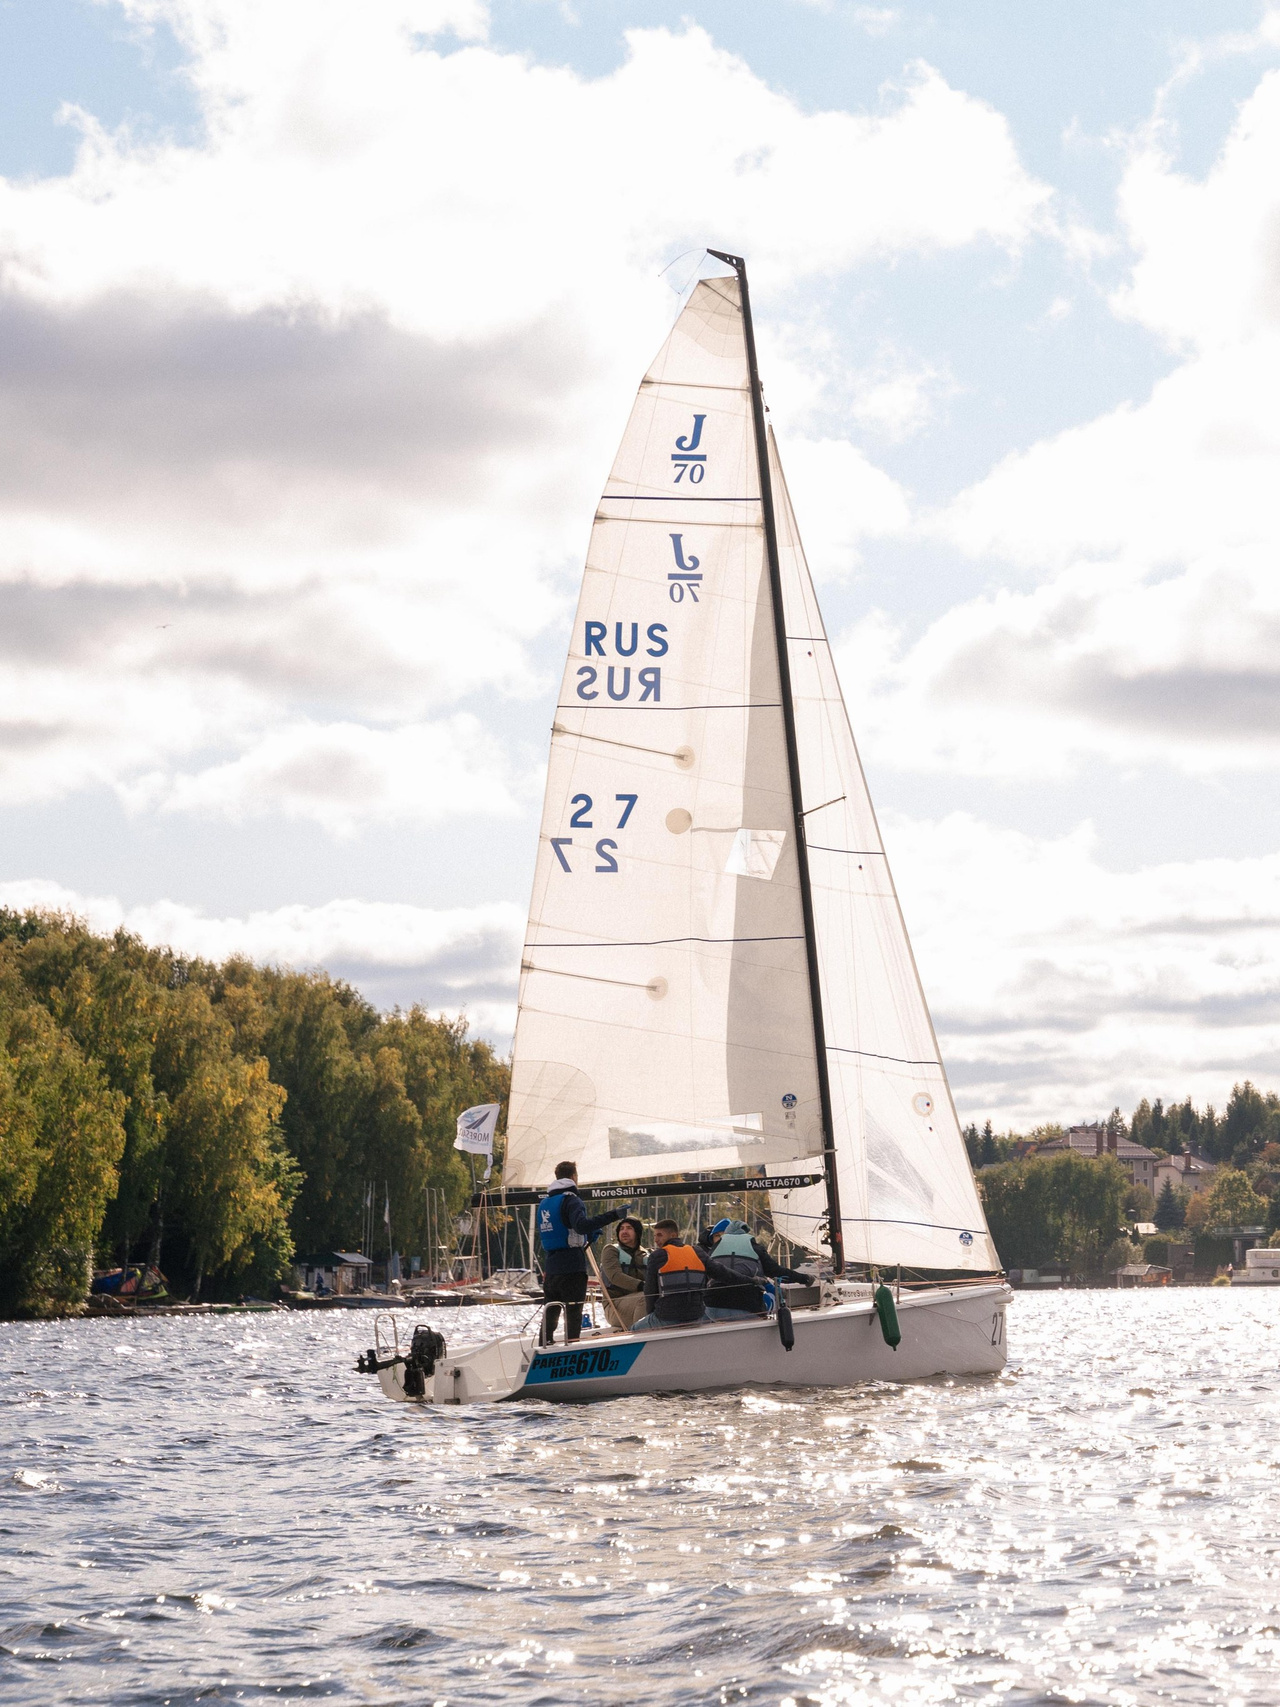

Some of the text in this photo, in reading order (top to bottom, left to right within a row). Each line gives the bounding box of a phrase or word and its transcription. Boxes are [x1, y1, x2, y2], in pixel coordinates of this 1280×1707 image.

[676, 414, 706, 451] J
[673, 463, 705, 484] 70
[585, 621, 669, 657] RUS
[570, 794, 638, 829] 27
[592, 1187, 648, 1198] MoreSail.ru
[991, 1312, 1004, 1346] 27
[550, 1365, 576, 1379] RUS
[576, 1348, 612, 1375] 670
[608, 1359, 620, 1372] 27
